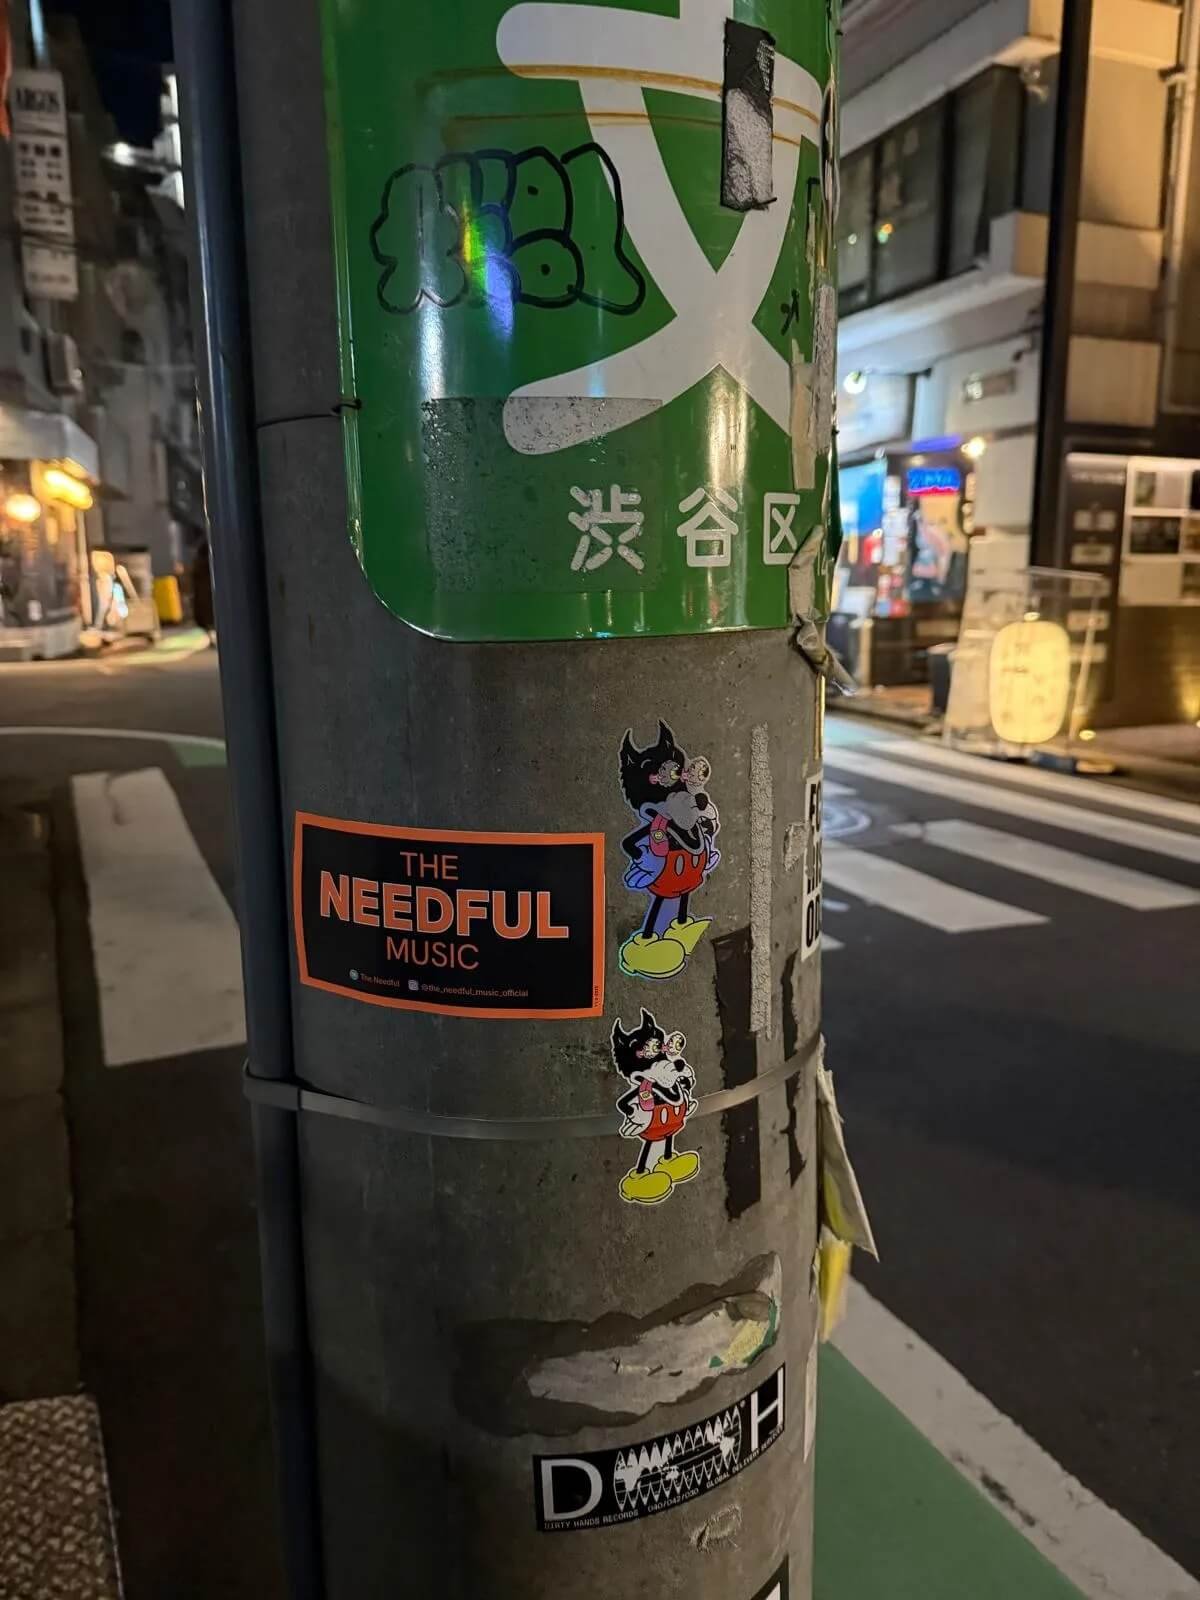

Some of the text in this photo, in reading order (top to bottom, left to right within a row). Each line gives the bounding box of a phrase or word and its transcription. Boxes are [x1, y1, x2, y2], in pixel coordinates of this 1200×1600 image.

[568, 484, 801, 571] 渋谷区
[400, 851, 459, 881] THE
[319, 870, 569, 939] NEEDFUL
[386, 935, 480, 970] MUSIC
[373, 975, 400, 988] Needful
[421, 983, 529, 997] @the_needful_music_official
[540, 1367, 784, 1521] D H
[573, 1517, 600, 1528] HANDS
[602, 1509, 639, 1524] RECORDS
[706, 1471, 730, 1489] GLOBAL
